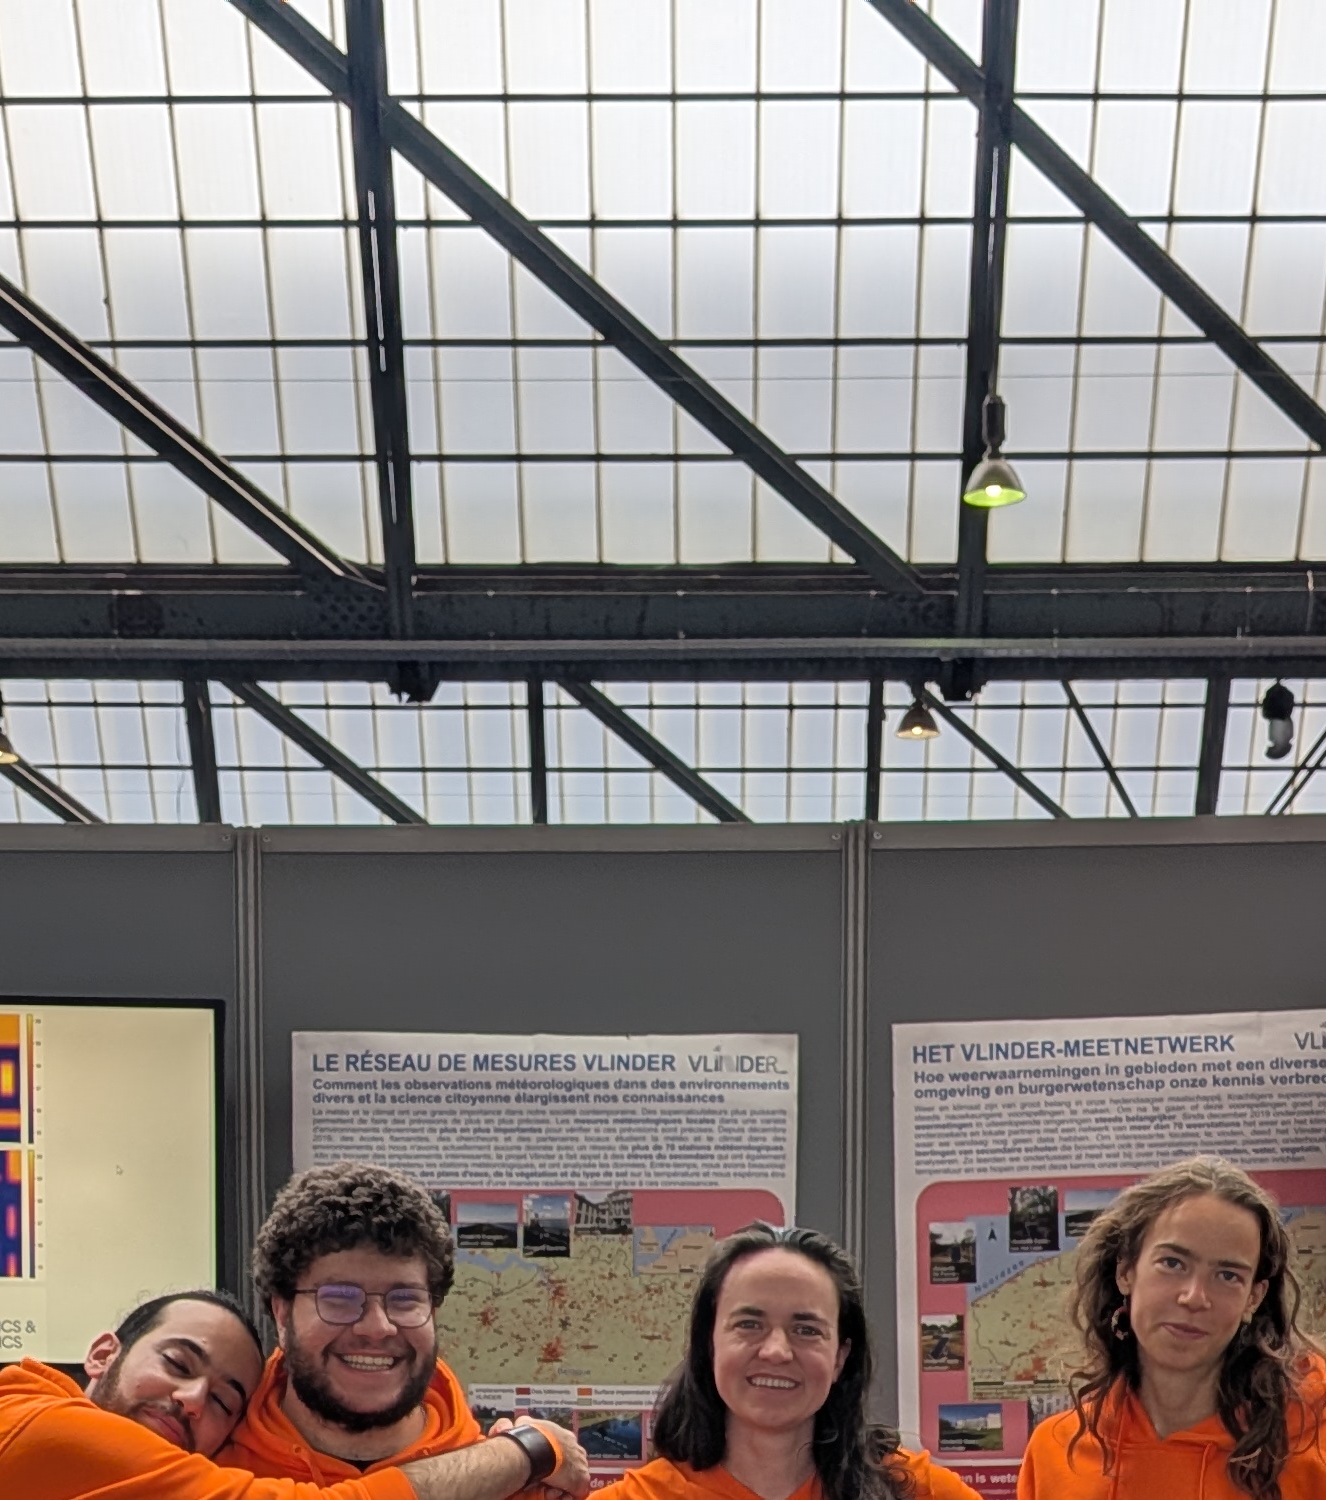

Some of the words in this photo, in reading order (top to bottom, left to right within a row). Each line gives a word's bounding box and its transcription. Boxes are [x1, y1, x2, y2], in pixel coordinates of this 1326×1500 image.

[312, 1053, 339, 1072] LE
[345, 1049, 431, 1073] RÉSEAU
[438, 1053, 466, 1072] DE
[473, 1053, 576, 1072] MESURES
[583, 1053, 676, 1072] VLINDER
[912, 1044, 955, 1064] HET
[960, 1034, 1235, 1062] VLINDER-MEETNETWERK
[913, 1071, 944, 1084] Hoe
[948, 1064, 1101, 1081] weerwaarnemingen
[1105, 1064, 1120, 1076] in
[1124, 1060, 1197, 1078] gebieden
[1201, 1060, 1232, 1073] met
[1235, 1060, 1265, 1071] een
[312, 1078, 378, 1091] Comment
[381, 1078, 401, 1091] les
[404, 1078, 492, 1091] observations
[495, 1077, 609, 1094] météorologiques
[613, 1078, 647, 1091] dans
[650, 1078, 673, 1091] des
[679, 1078, 790, 1091] environnements
[913, 1085, 991, 1101] omgeving
[994, 1085, 1014, 1096] en
[1018, 1076, 1165, 1096] burgerwetenschap
[1169, 1077, 1207, 1089] onze
[1212, 1073, 1265, 1087] kennis
[312, 1092, 354, 1104] divers
[358, 1093, 371, 1104] et
[374, 1092, 387, 1104] la
[390, 1092, 442, 1104] science
[445, 1092, 511, 1107] citoyenne
[515, 1091, 590, 1107] élargissent
[593, 1094, 619, 1104] nos
[622, 1092, 725, 1104] connaissances
[25, 1319, 37, 1333] &
